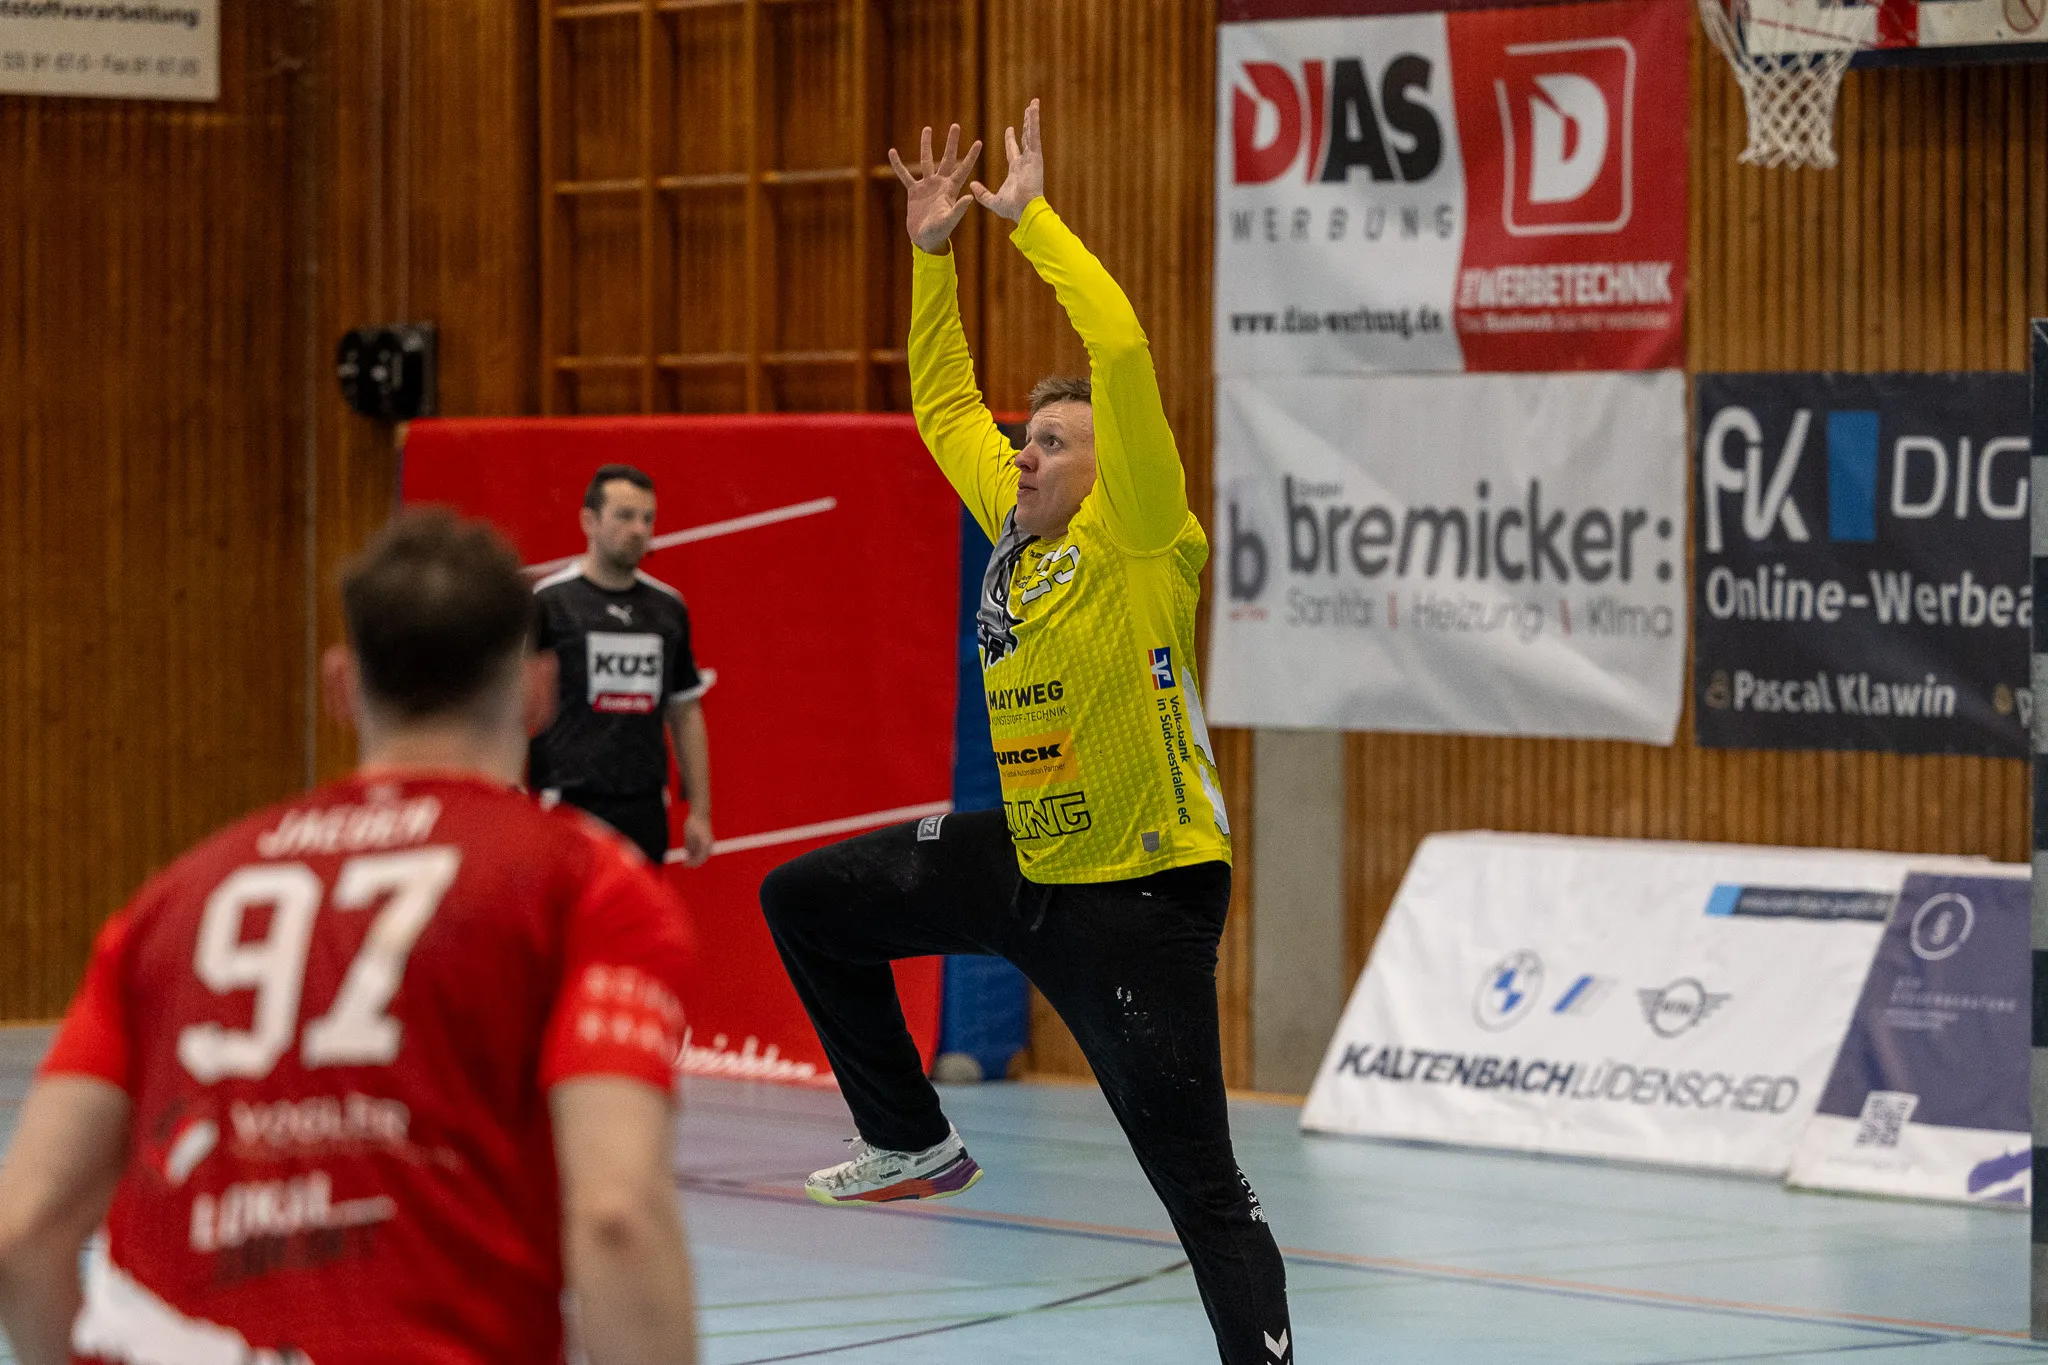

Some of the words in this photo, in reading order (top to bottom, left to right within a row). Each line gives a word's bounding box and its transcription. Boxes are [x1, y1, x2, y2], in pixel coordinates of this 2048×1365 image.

[1231, 52, 1443, 188] DIAS
[1230, 203, 1455, 244] WERBUNG
[1584, 597, 1675, 639] Klima
[594, 652, 657, 677] KUS
[988, 680, 1064, 711] MAYWEG
[1156, 697, 1167, 712] in
[1733, 669, 1835, 716] Pascal
[1836, 671, 1957, 718] Klawin
[1170, 695, 1191, 763] Volksbank
[994, 743, 1062, 765] URCK
[1160, 714, 1186, 804] Südwestfalen
[1003, 791, 1092, 840] UNG
[1176, 807, 1192, 826] eG
[176, 844, 464, 1084] 97
